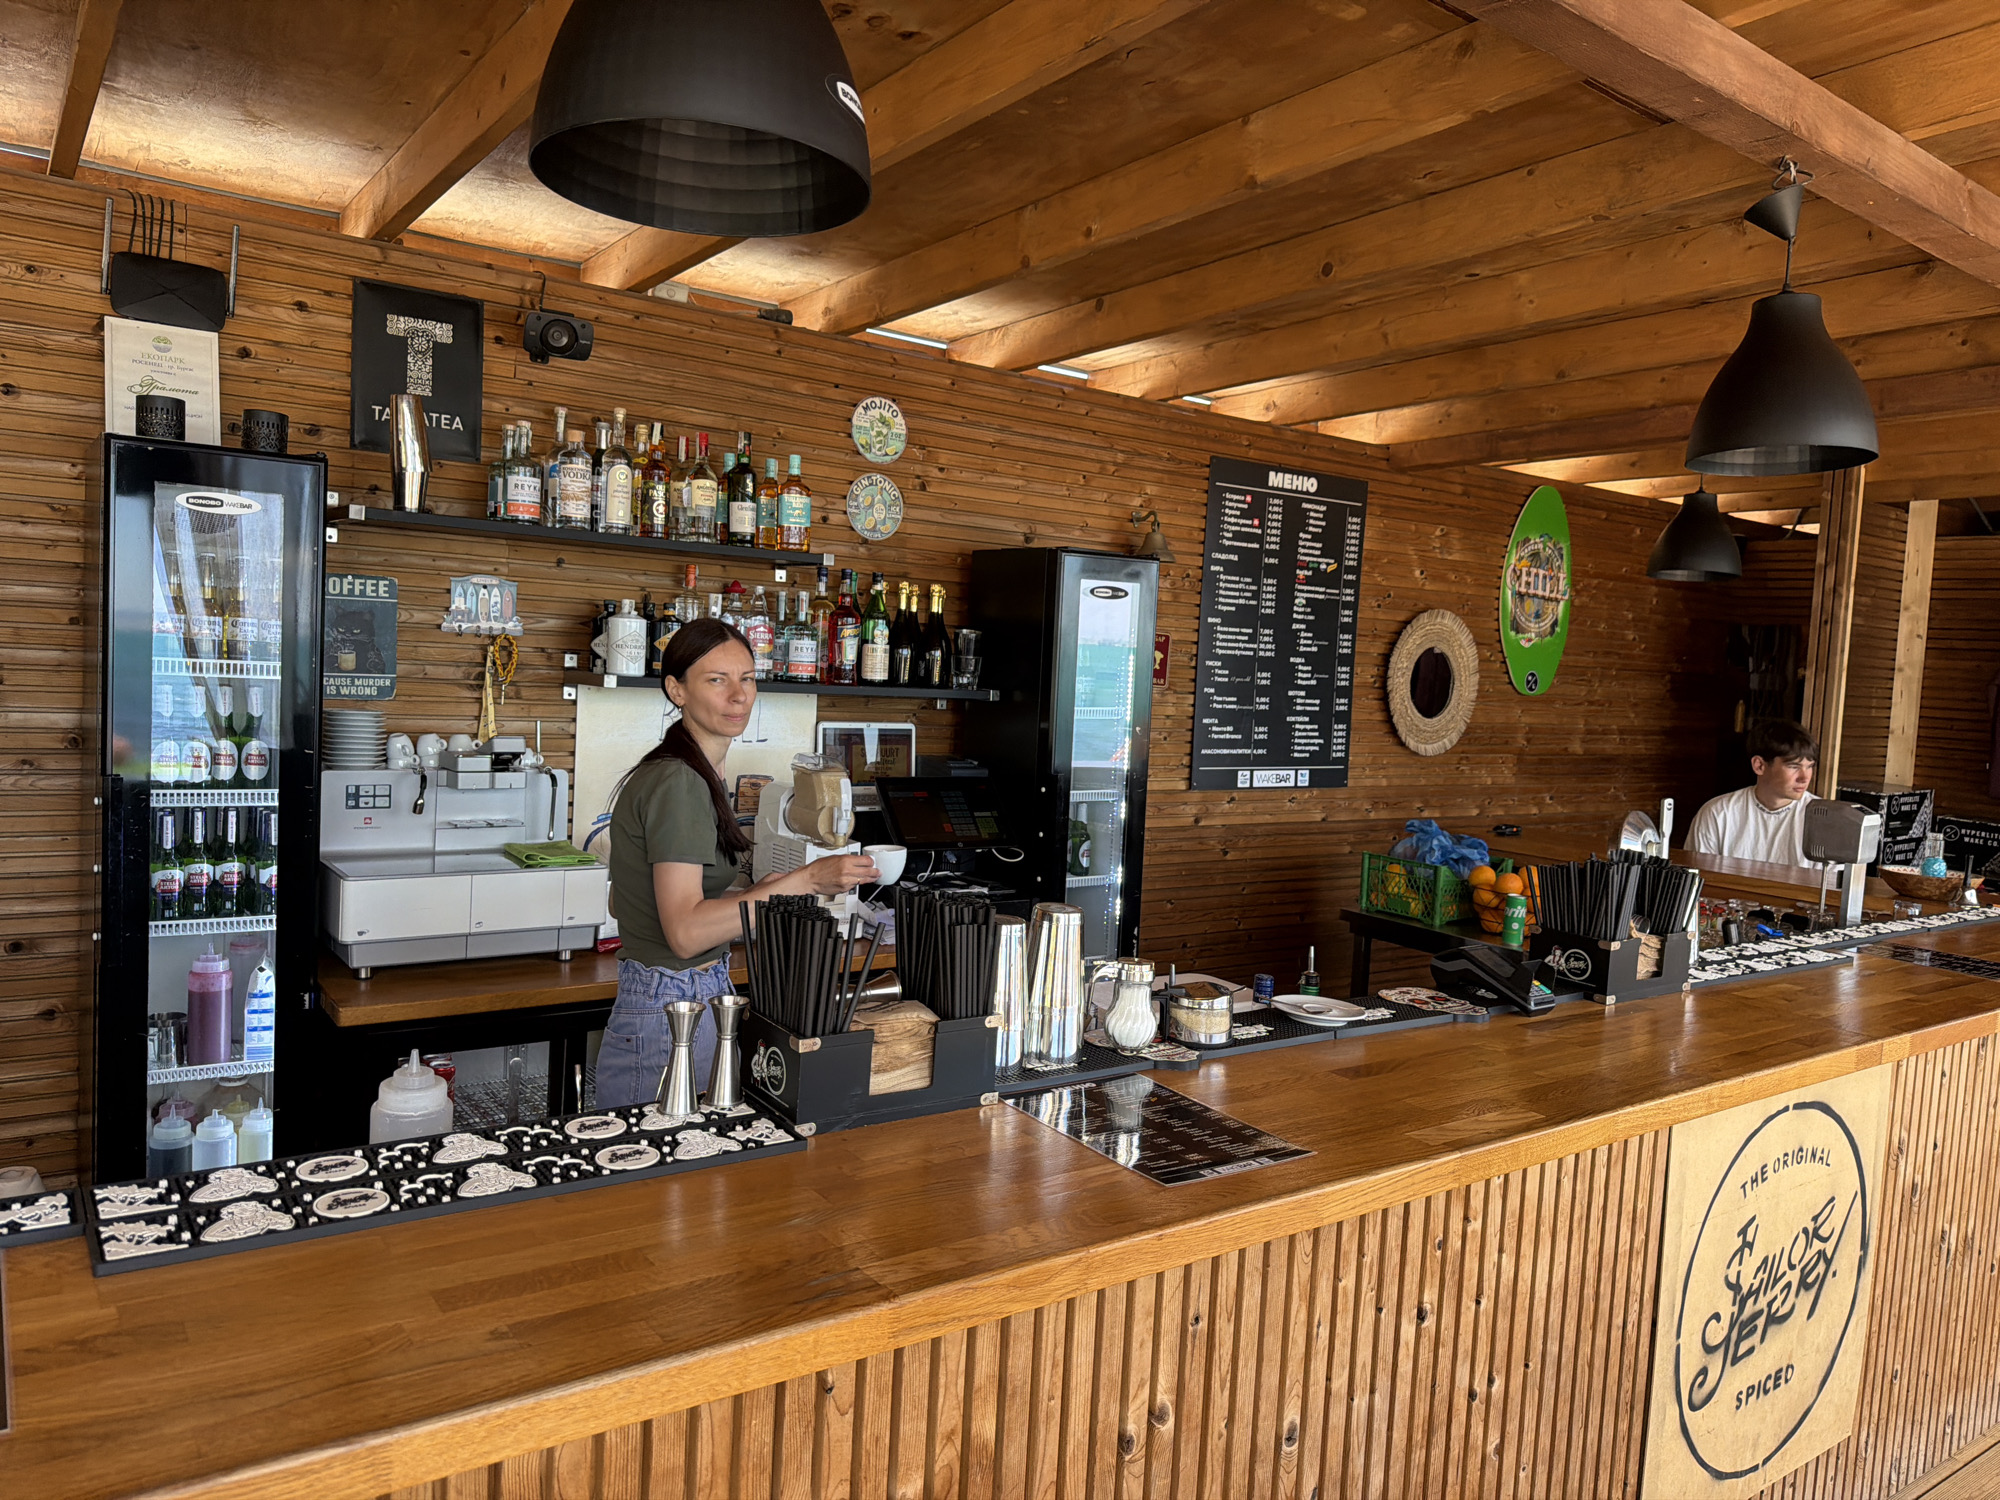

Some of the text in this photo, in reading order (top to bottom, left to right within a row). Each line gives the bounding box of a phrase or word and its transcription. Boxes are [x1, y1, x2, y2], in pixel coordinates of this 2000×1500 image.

[141, 352, 186, 364] ЕКОПАРК
[127, 375, 199, 396] Грамота
[372, 406, 464, 431] TAATEA
[862, 400, 899, 418] MOJITO
[853, 477, 869, 495] GIN
[871, 476, 898, 500] TONIC
[1268, 471, 1318, 493] МЕНЮ
[188, 498, 221, 506] BONOBO
[328, 576, 389, 597] OFFEE
[1506, 562, 1570, 600] CHILL
[749, 631, 772, 639] SIERRA
[324, 677, 391, 686] CAUSE MURDER
[326, 686, 377, 696] IS WRONG
[1895, 842, 1915, 851] HYPERLITE
[1504, 906, 1526, 918] prit
[1740, 1146, 1831, 1199] THE ORIGINAL
[1735, 1362, 1795, 1411] SPICED
